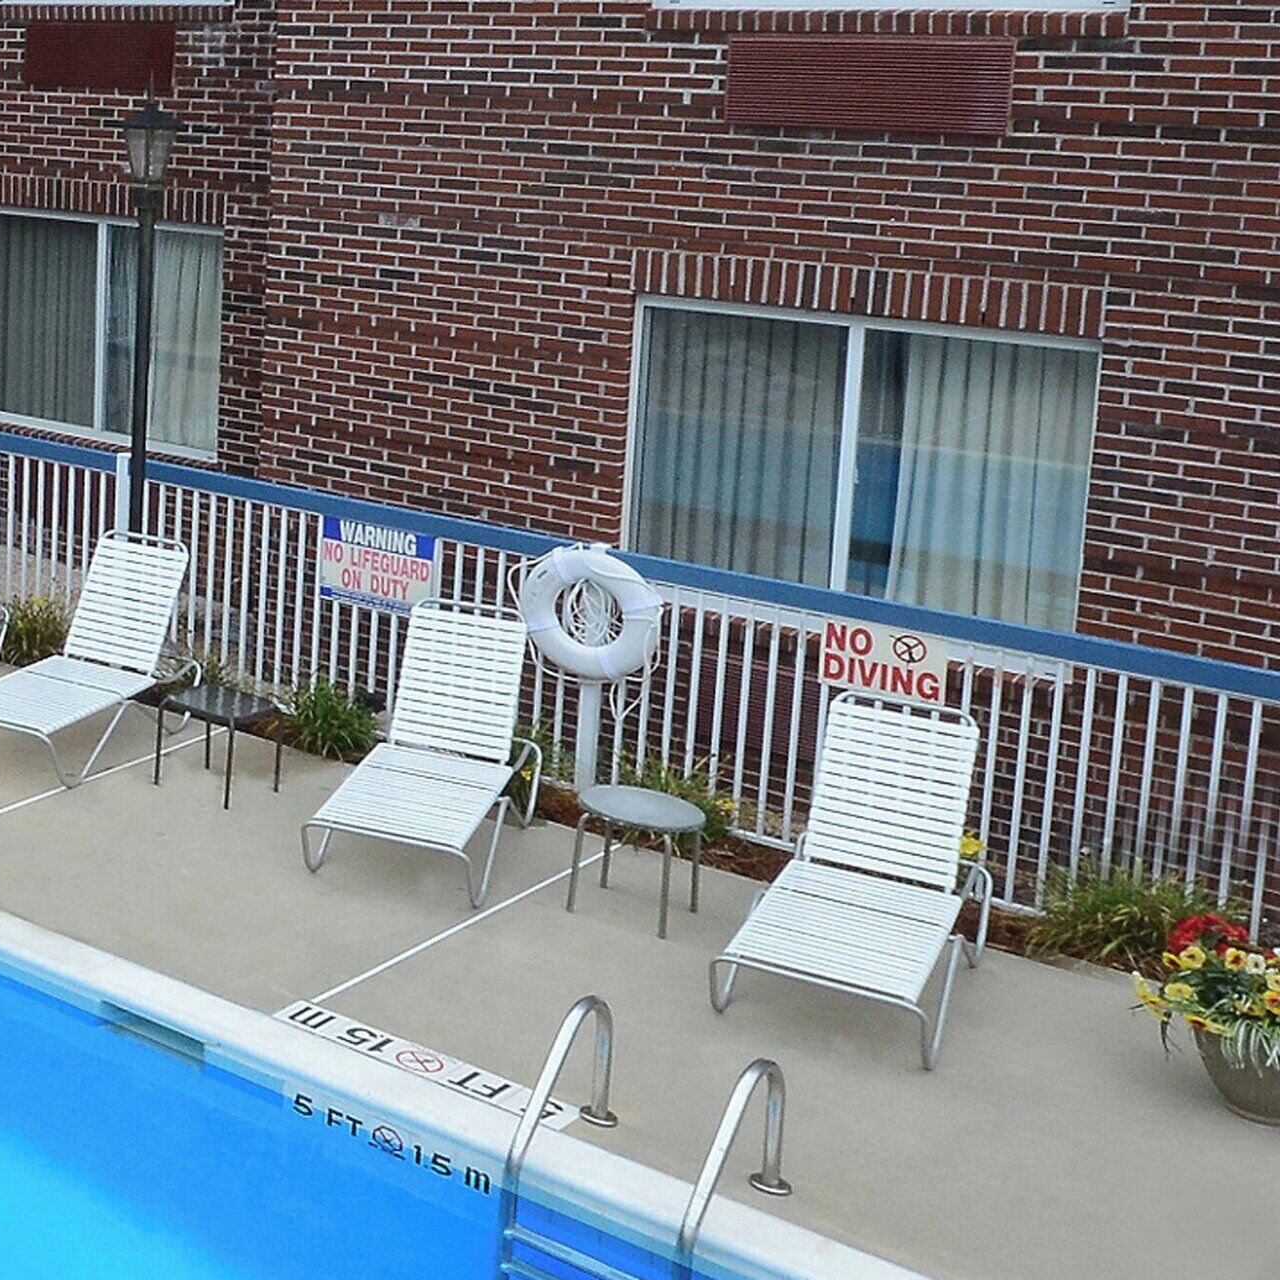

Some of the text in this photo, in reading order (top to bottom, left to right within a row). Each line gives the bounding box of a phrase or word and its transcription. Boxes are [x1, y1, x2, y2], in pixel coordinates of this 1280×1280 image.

[340, 519, 417, 556] WARNING
[324, 541, 430, 581] NO LIFEGUARD
[342, 568, 409, 600] ON DUTY
[826, 622, 873, 656] NO
[824, 652, 940, 701] DIVING
[288, 1006, 337, 1029] m
[447, 1072, 511, 1098] FT
[293, 1093, 313, 1117] 5
[327, 1108, 363, 1137] FT
[465, 1166, 490, 1195] m
